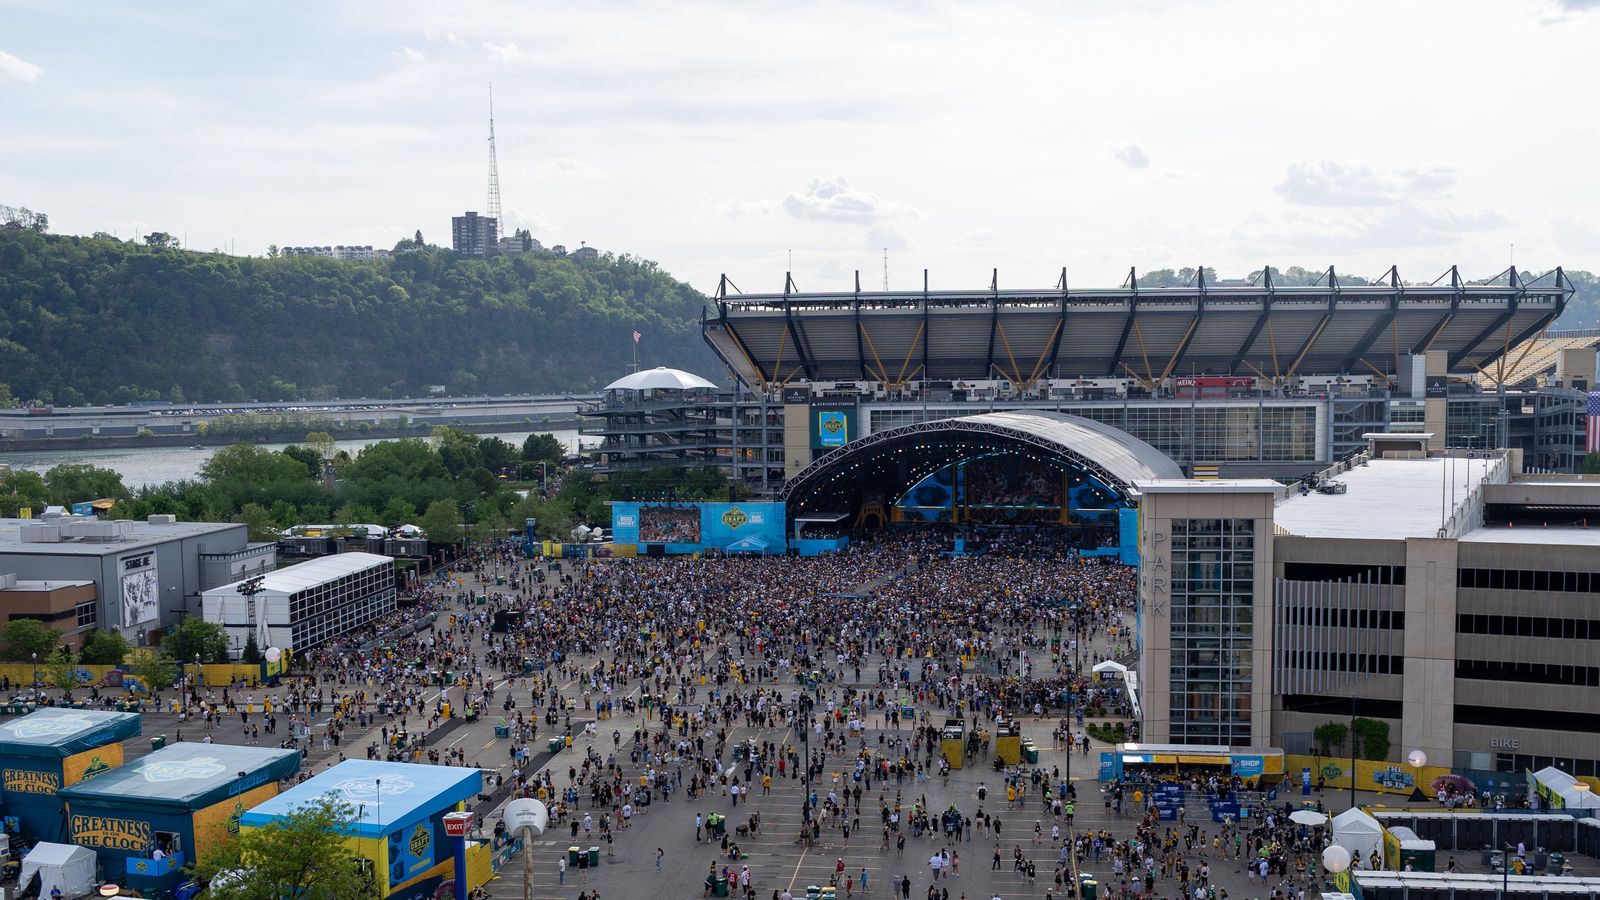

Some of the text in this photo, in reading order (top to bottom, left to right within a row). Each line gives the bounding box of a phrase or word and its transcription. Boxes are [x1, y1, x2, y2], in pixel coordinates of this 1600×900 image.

[125, 556, 150, 570] STAGE AE
[1152, 531, 1167, 616] PARK
[1490, 738, 1520, 749] BIKE
[1240, 759, 1260, 767] SHOP
[1384, 765, 1402, 773] THE
[3, 768, 58, 788] GREATNESS
[1373, 770, 1414, 786] PICK
[1383, 780, 1406, 789] IS IN
[4, 783, 57, 795] THE CLOCK
[72, 815, 150, 840] GREATNESS
[447, 823, 464, 831] EXIT
[74, 835, 147, 851] THE CLOCK
[410, 835, 430, 850] DRAFT
